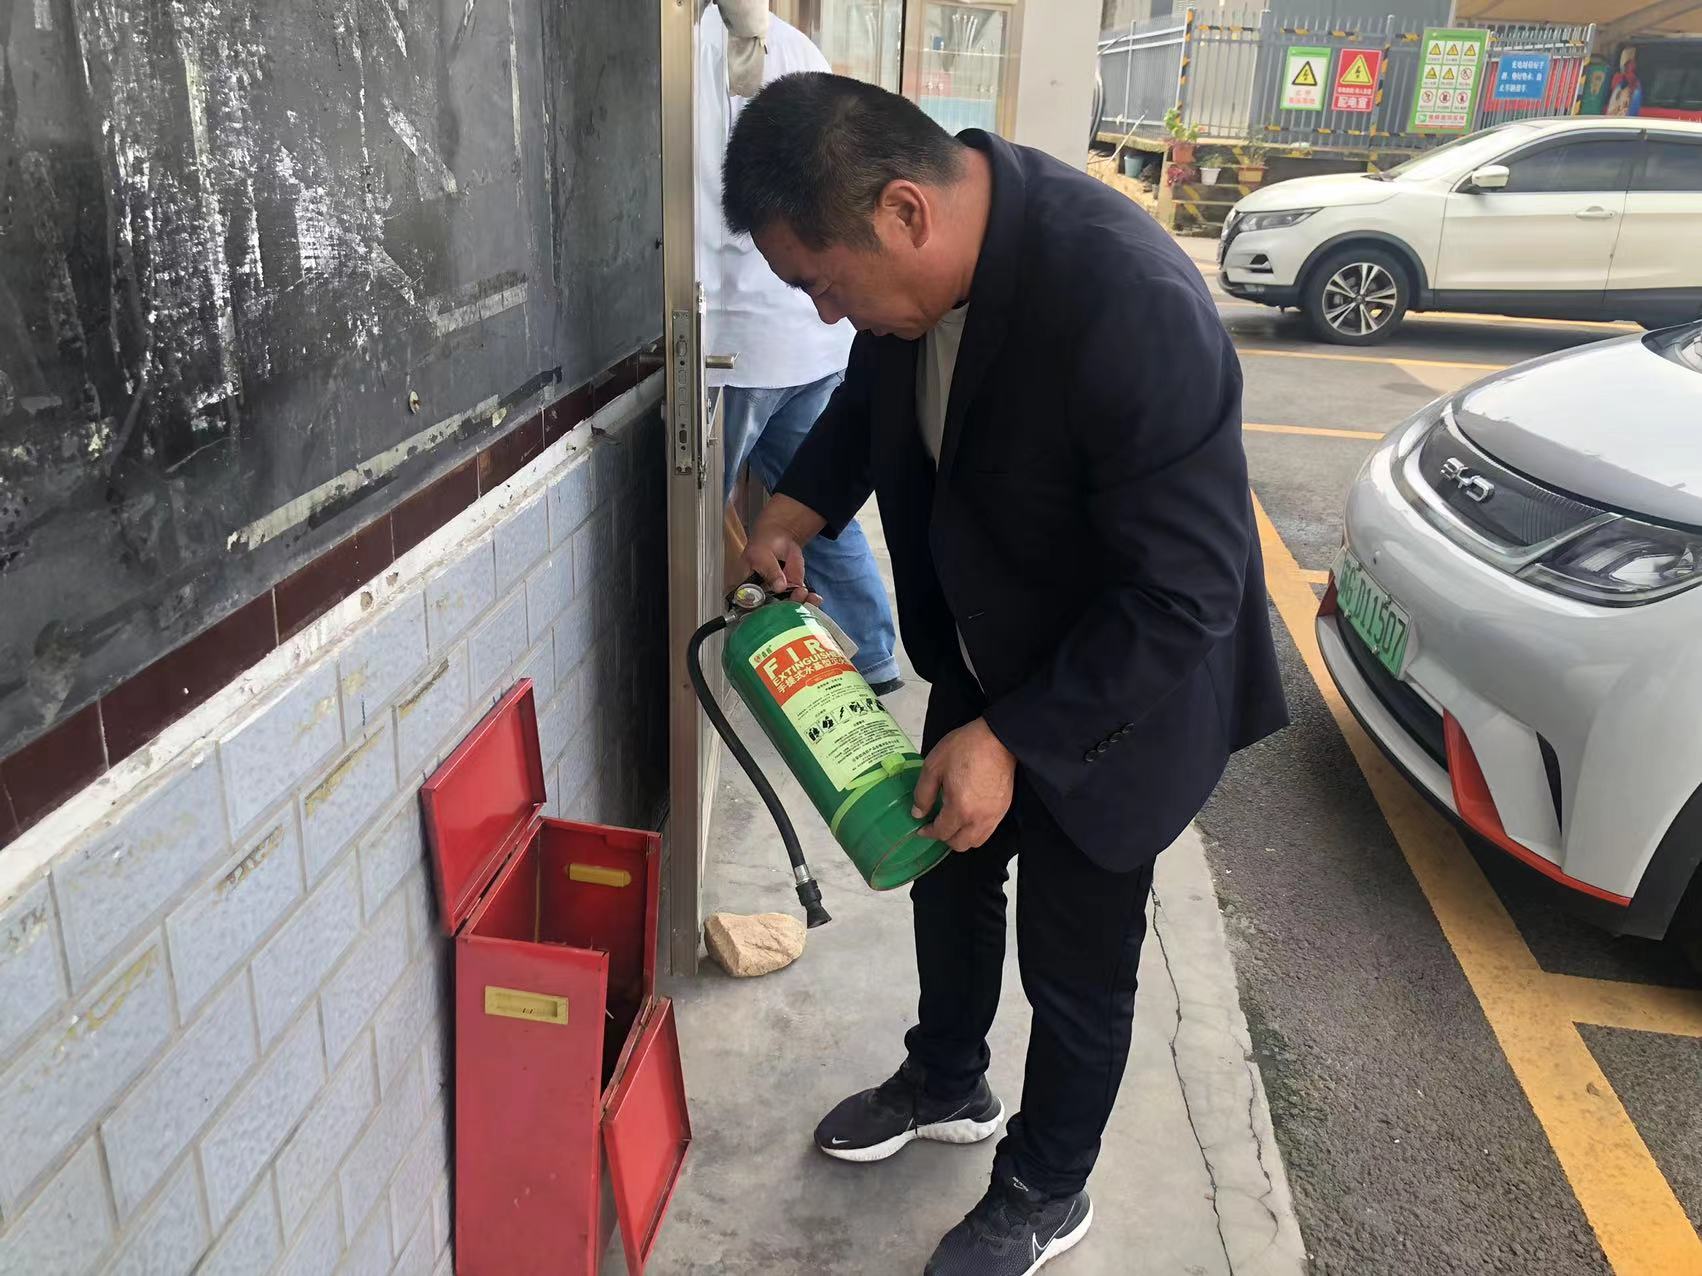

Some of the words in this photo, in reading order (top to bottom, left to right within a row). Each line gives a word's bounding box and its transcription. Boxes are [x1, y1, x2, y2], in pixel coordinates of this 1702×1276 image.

[1440, 457, 1495, 502] BYD
[763, 639, 824, 680] FIR
[772, 649, 840, 688] EXTINGUISH
